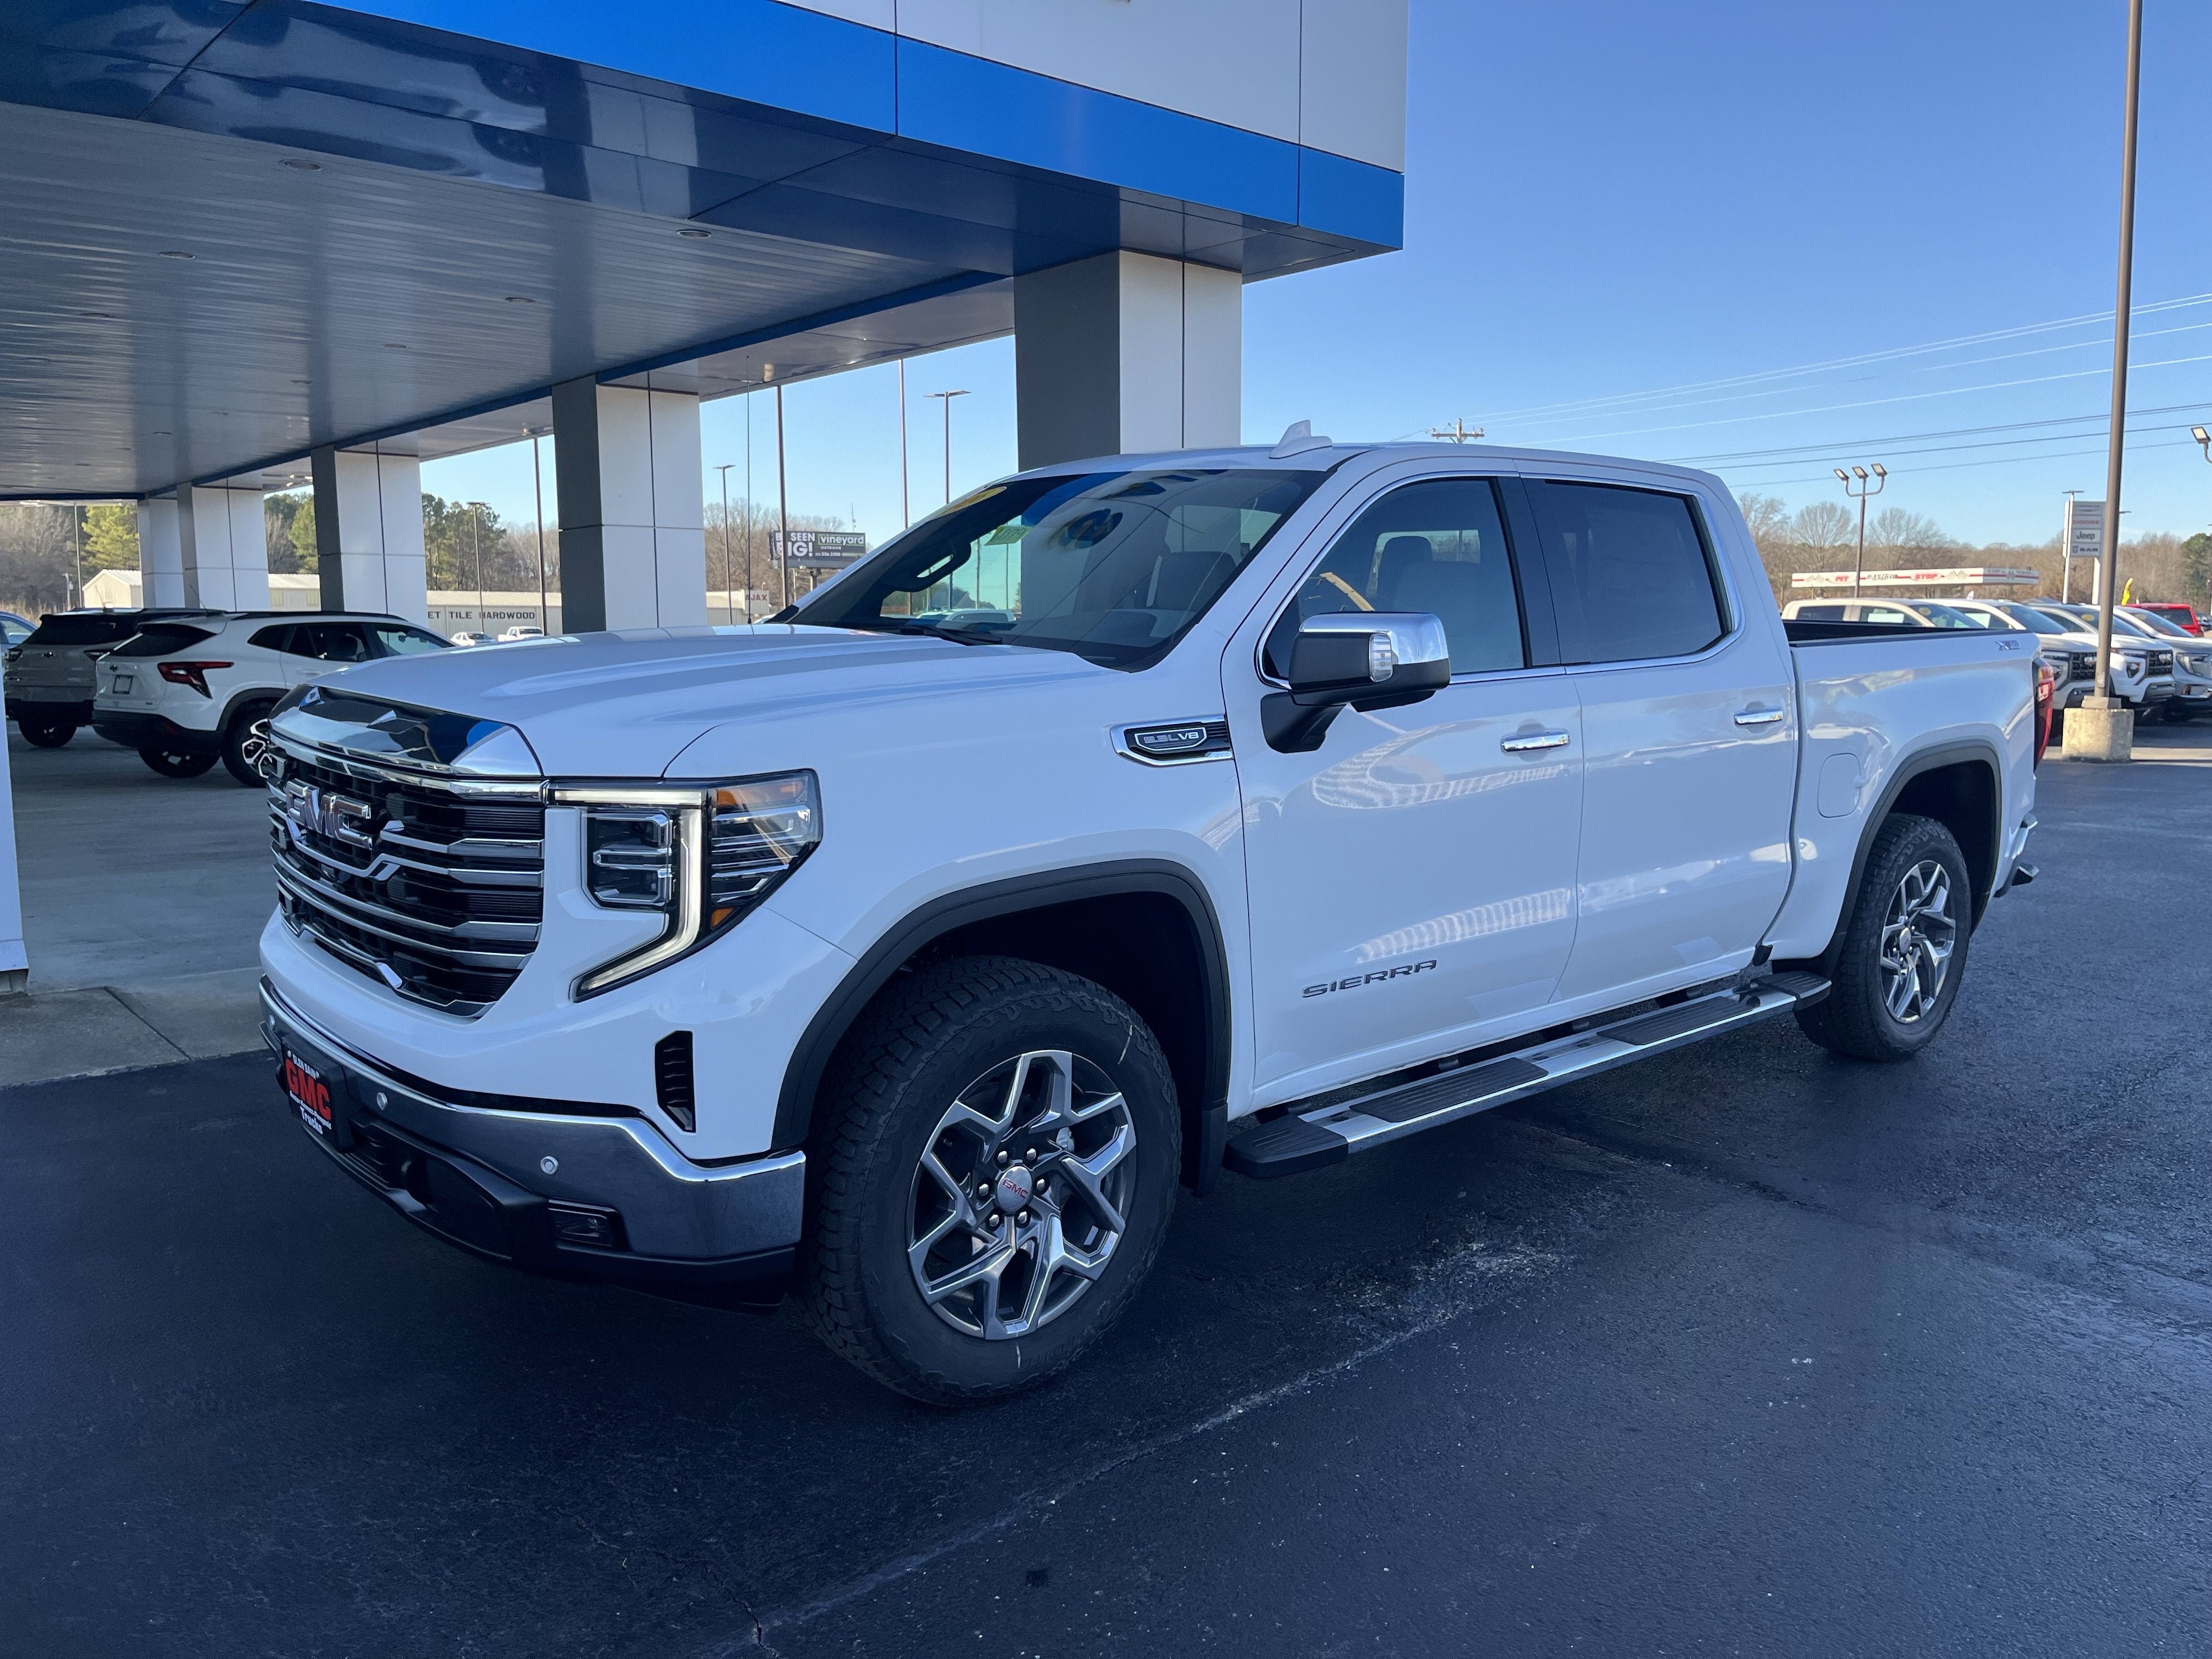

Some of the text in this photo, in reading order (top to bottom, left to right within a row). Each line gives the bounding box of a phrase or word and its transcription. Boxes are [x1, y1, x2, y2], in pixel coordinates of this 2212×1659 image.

[790, 532, 815, 541] SEEN
[820, 534, 865, 546] vineyard
[2076, 531, 2095, 541] Jeep
[449, 611, 472, 619] TILE
[286, 780, 373, 850] GMC
[1302, 959, 1437, 998] SIERRA
[285, 1058, 332, 1121] GMC
[300, 1105, 323, 1135] Trucks
[1003, 1178, 1029, 1199] GMC
